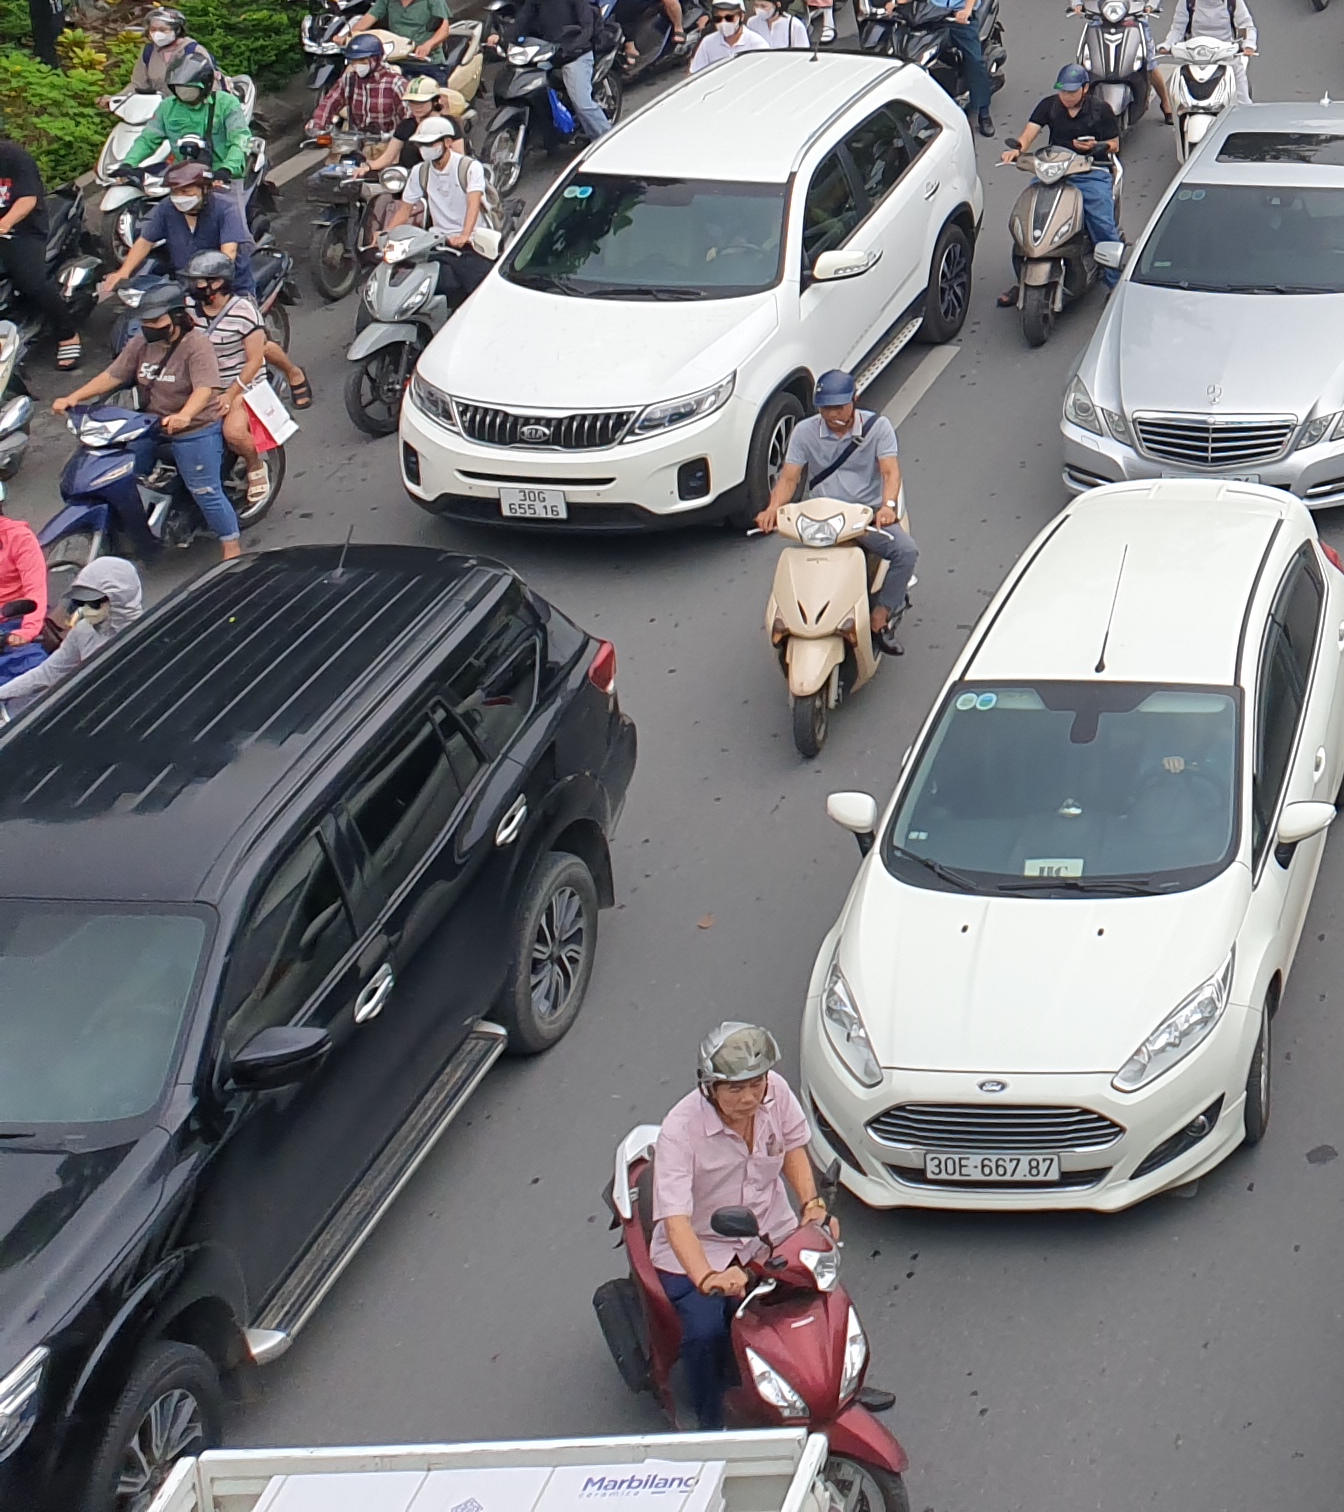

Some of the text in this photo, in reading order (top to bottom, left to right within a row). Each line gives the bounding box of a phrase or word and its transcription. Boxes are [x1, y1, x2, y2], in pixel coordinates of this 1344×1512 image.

[524, 429, 544, 439] KIA
[518, 489, 546, 503] 30G
[929, 1156, 1054, 1178] 30E-667.87
